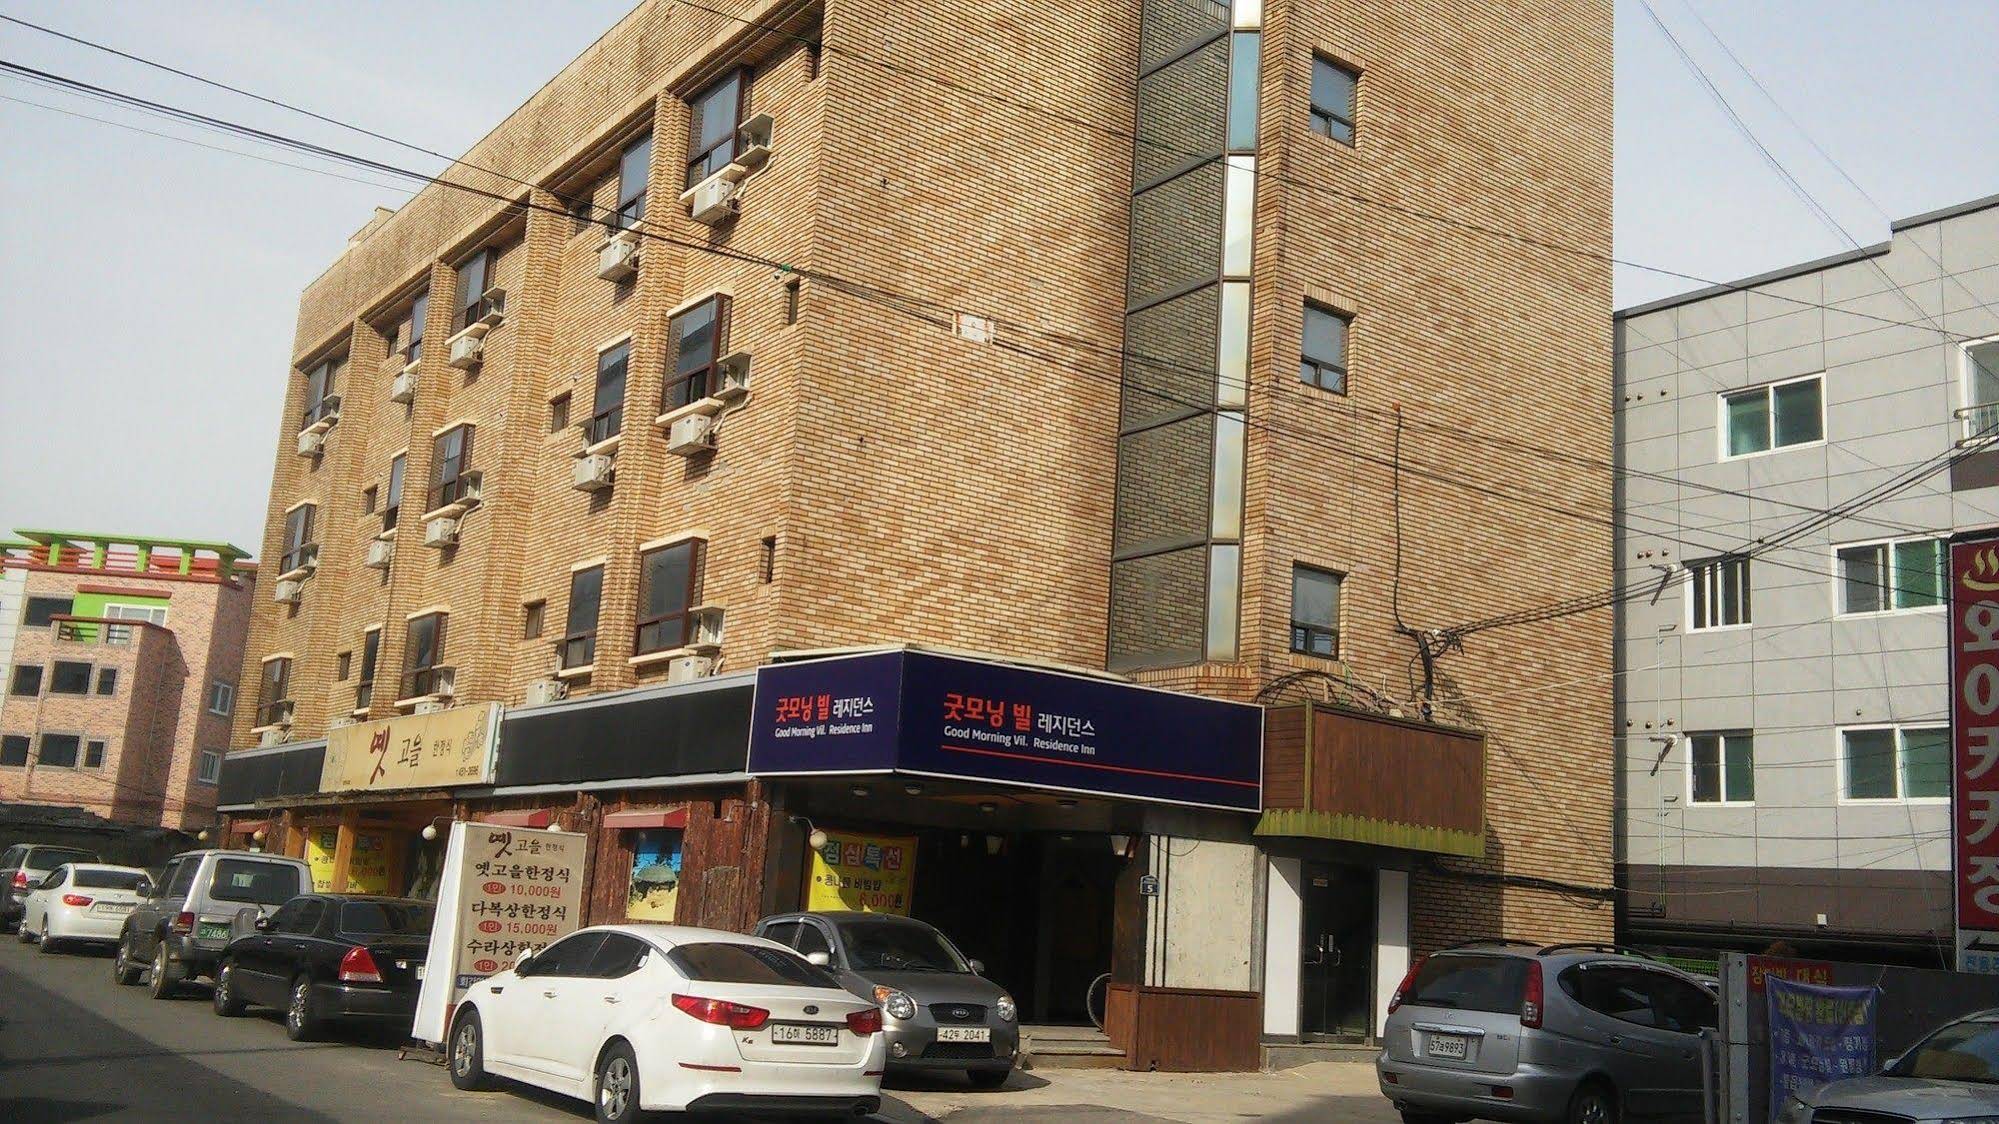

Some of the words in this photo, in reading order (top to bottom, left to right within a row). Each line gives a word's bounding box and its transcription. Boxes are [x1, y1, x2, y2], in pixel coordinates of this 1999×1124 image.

[776, 696, 813, 722] 굿모닝
[817, 694, 830, 721] 빌
[833, 697, 874, 718] 레지던스
[944, 693, 1005, 728] 굿모닝
[1013, 703, 1032, 732] 빌
[1038, 713, 1095, 737] 레지던스
[775, 727, 790, 738] Good
[791, 726, 816, 739] Morning
[829, 723, 860, 735] Residence
[861, 723, 873, 733] Inn
[944, 725, 970, 739] Good
[972, 729, 1011, 747] Morning
[1013, 735, 1029, 747] Vil.
[1033, 737, 1079, 753] Residence
[1081, 744, 1095, 755] Inn
[370, 725, 391, 785] 옛
[397, 734, 422, 768] 고을
[488, 831, 513, 858] 옛
[515, 838, 542, 855] 고을
[475, 861, 570, 883] 옛고을한정식
[1146, 884, 1154, 893] 5
[471, 901, 567, 920] 다복상한정식
[805, 1028, 832, 1040] 5887
[964, 1029, 985, 1040] 2041
